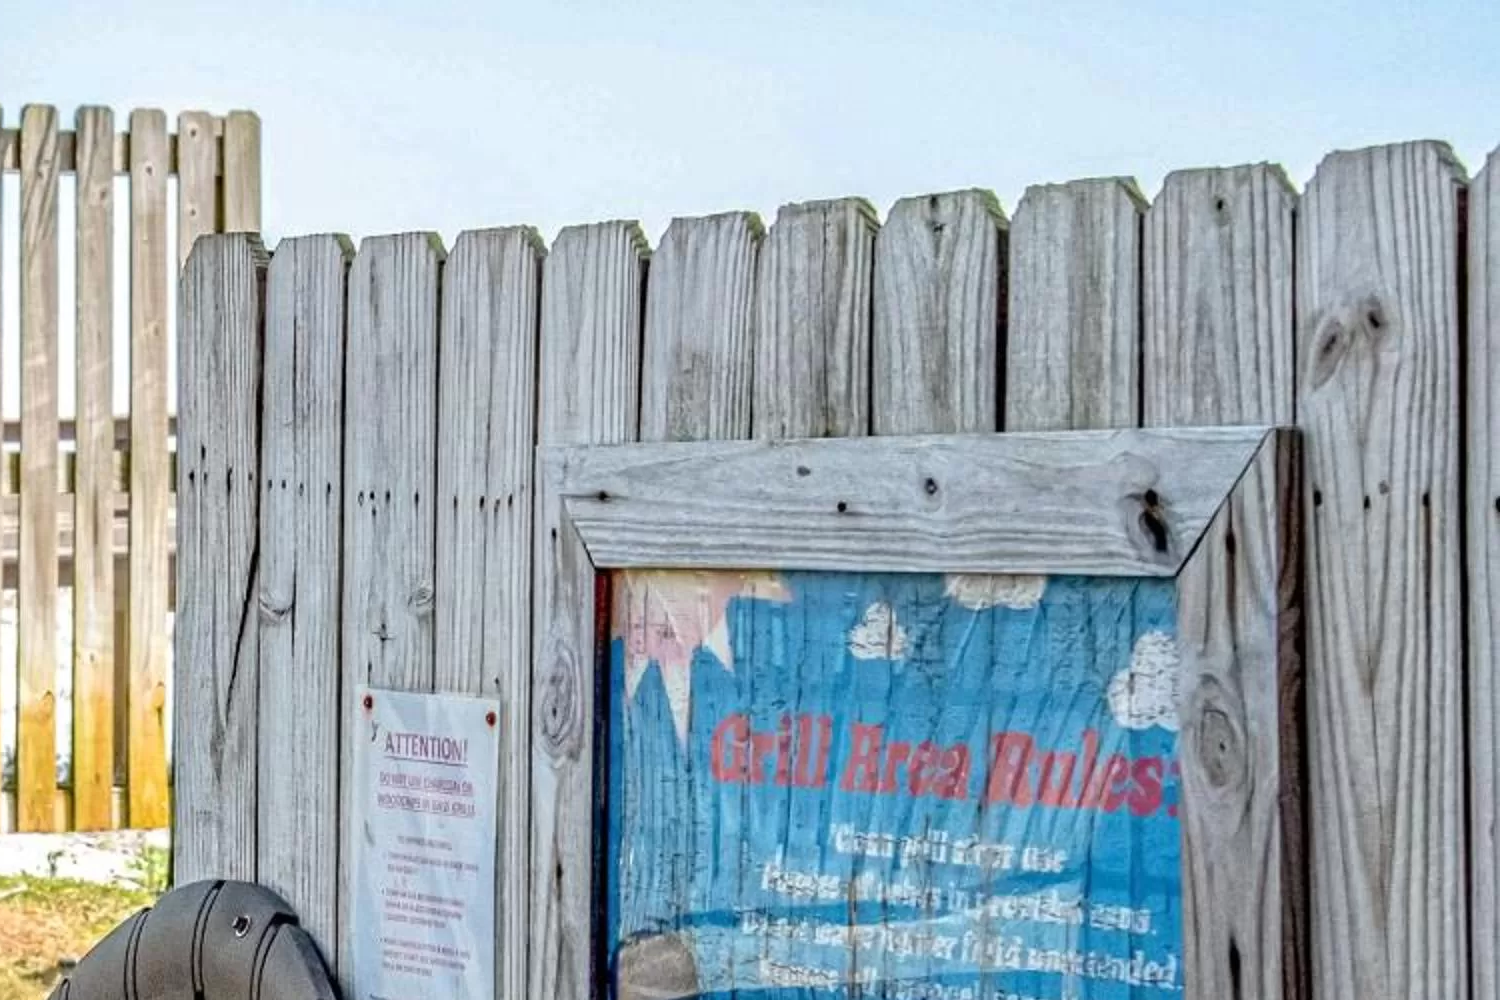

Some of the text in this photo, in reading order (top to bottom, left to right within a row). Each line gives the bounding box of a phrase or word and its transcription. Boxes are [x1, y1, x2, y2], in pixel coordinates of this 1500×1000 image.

[384, 732, 468, 762] ATTENTION!
[710, 712, 832, 788] Grill
[840, 722, 970, 799] Area
[834, 823, 894, 857] Clean
